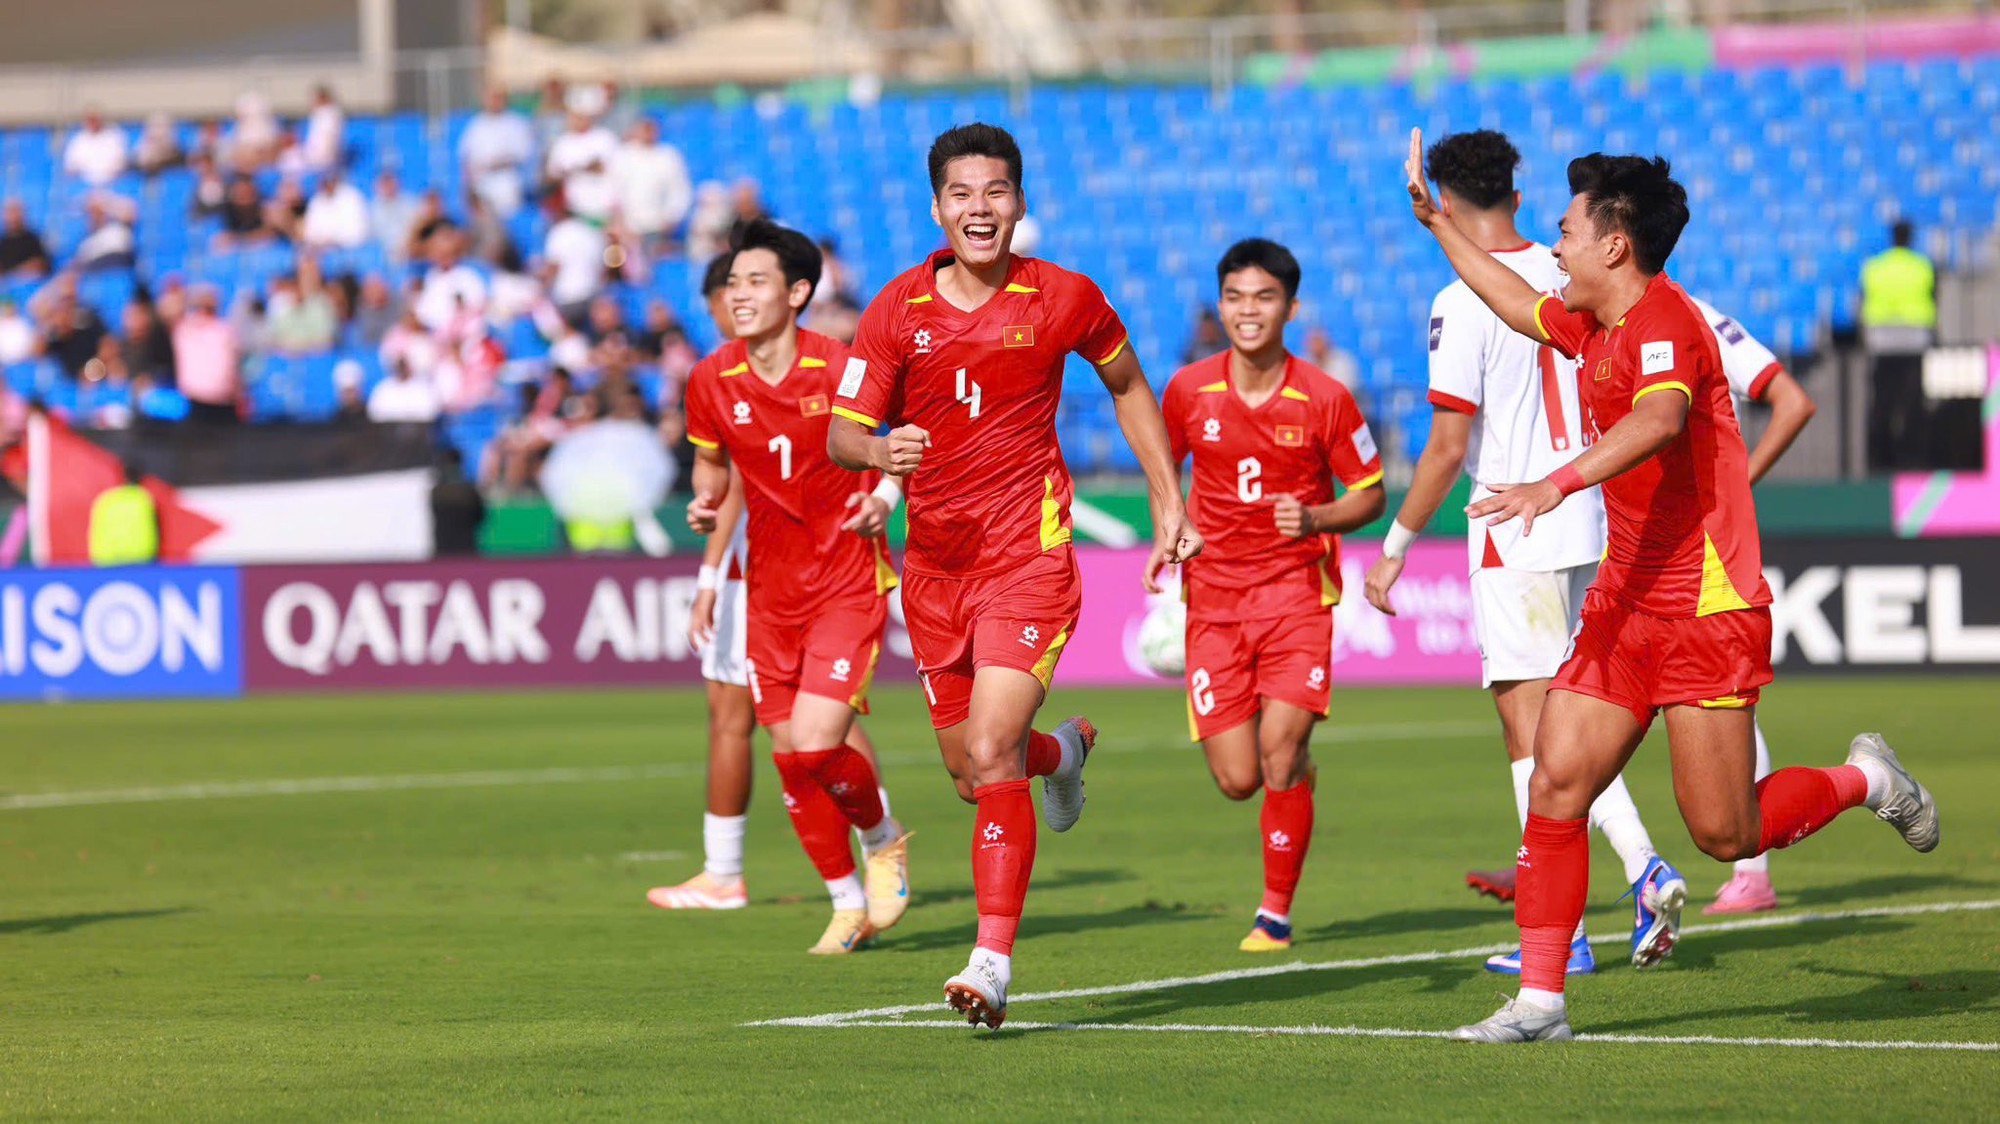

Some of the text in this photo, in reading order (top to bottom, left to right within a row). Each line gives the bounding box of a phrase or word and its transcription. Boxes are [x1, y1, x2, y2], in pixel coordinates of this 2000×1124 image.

[1646, 351, 1668, 361] AFC
[955, 367, 982, 419] 4
[768, 433, 792, 481] 7
[1237, 456, 1262, 504] 2
[263, 581, 550, 675] QATAR
[1191, 667, 1216, 717] 2
